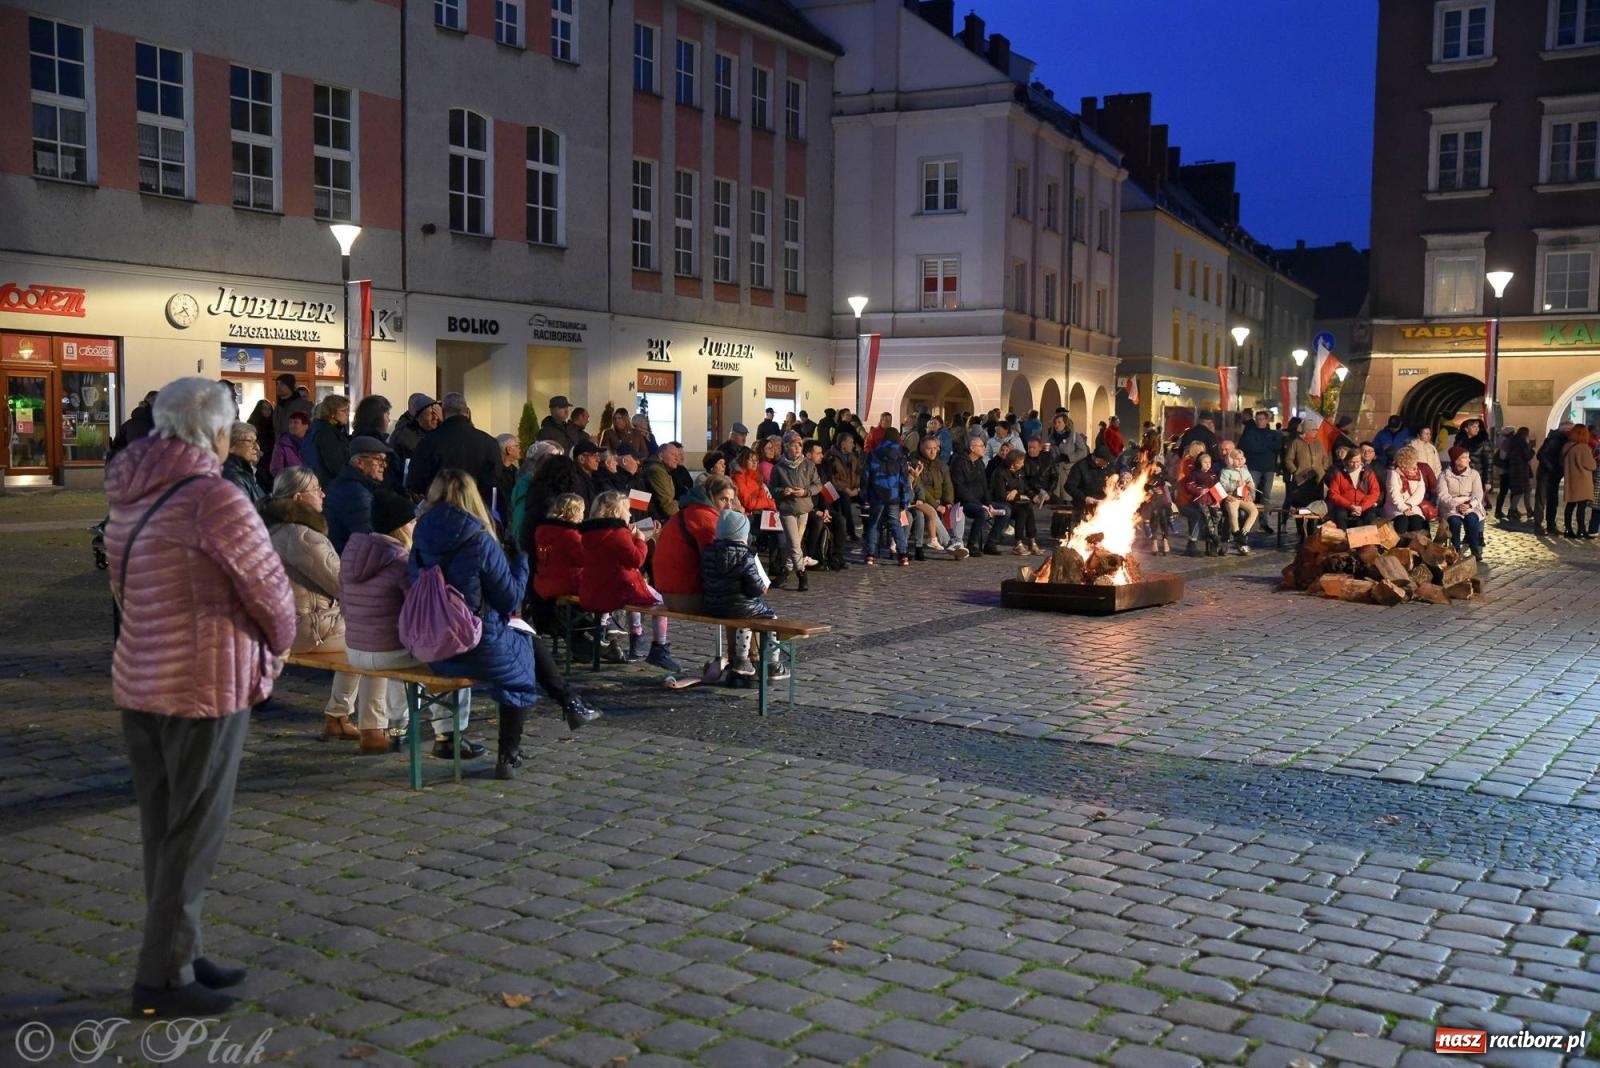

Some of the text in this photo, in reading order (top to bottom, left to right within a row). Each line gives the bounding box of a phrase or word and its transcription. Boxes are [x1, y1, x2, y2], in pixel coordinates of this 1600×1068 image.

[229, 323, 320, 342] ZEGARMISTRZ
[447, 316, 499, 335] BOLKO
[547, 319, 587, 331] RESTAURACJA
[533, 328, 583, 343] RACIBORSKA
